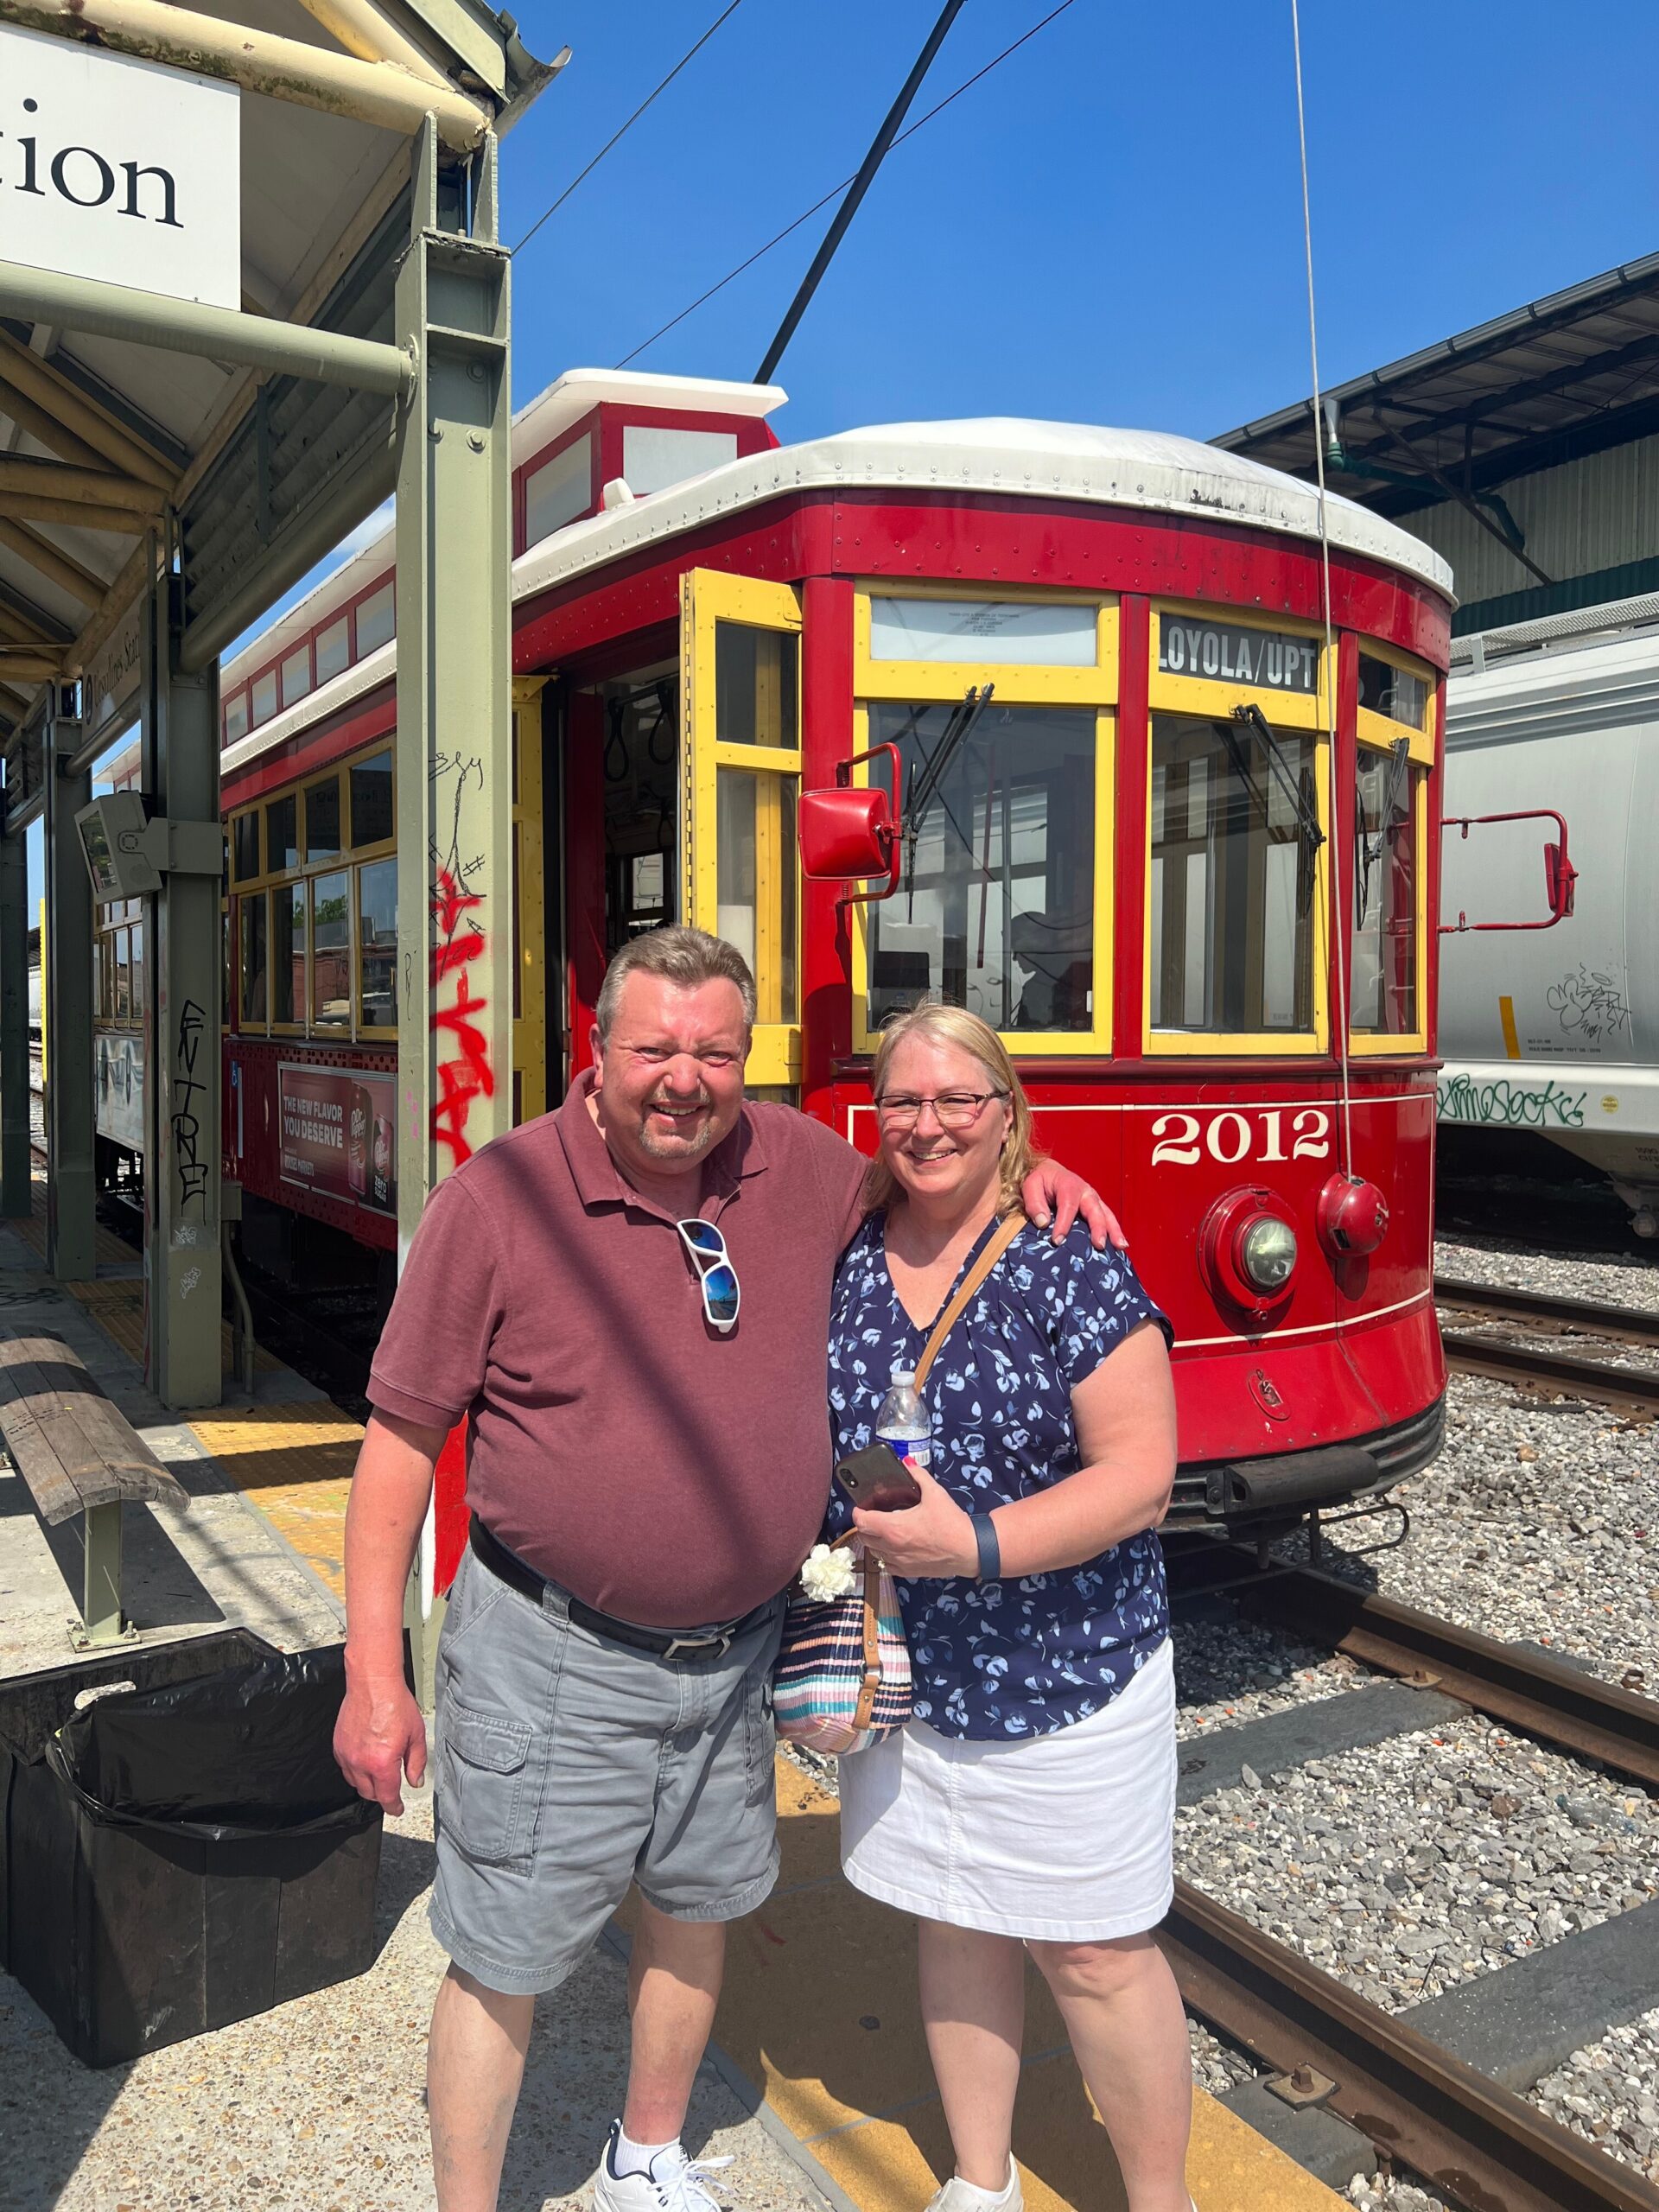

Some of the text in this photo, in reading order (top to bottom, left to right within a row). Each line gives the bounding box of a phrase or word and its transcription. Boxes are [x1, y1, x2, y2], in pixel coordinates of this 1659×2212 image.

[0, 98, 184, 228] ion
[283, 1096, 343, 1122] THE NEW FLAVOR
[283, 1116, 344, 1148] YOU DESERVE
[1151, 1109, 1329, 1166] 2012
